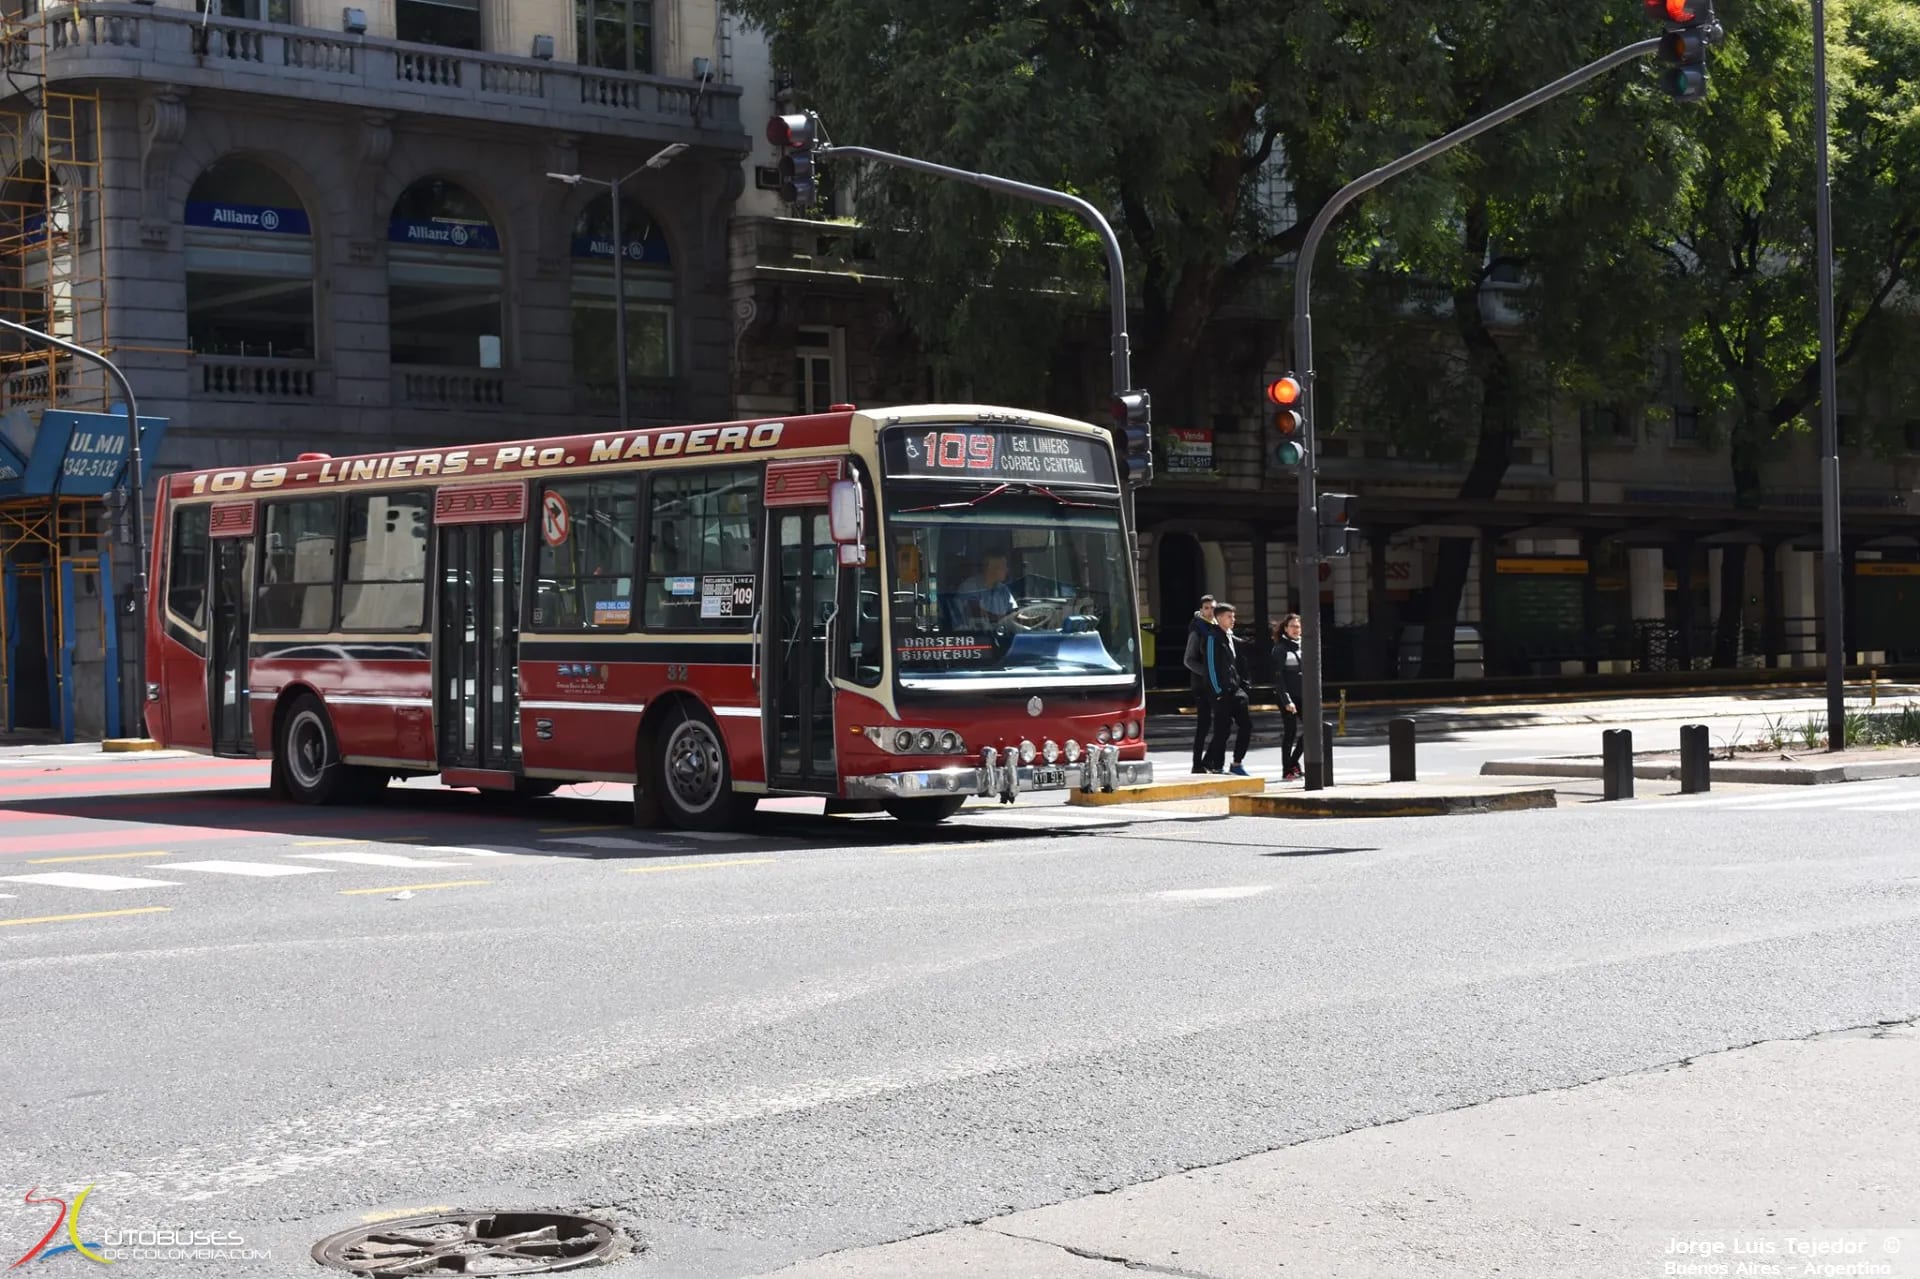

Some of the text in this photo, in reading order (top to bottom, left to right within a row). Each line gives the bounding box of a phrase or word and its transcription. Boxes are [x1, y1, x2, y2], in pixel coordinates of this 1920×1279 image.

[212, 208, 259, 225] Allianz
[407, 225, 449, 241] Allianz
[589, 240, 629, 256] Alliaz
[70, 431, 126, 455] ULMA
[922, 431, 996, 470] 109
[1032, 437, 1070, 455] LINIERS
[192, 466, 288, 495] 109
[588, 422, 785, 463] MADERO
[1043, 456, 1087, 474] CENTRAL
[733, 587, 753, 605] 109
[720, 601, 732, 613] 32
[903, 636, 976, 648] DARSENA
[901, 649, 983, 662] BUQUEBUS
